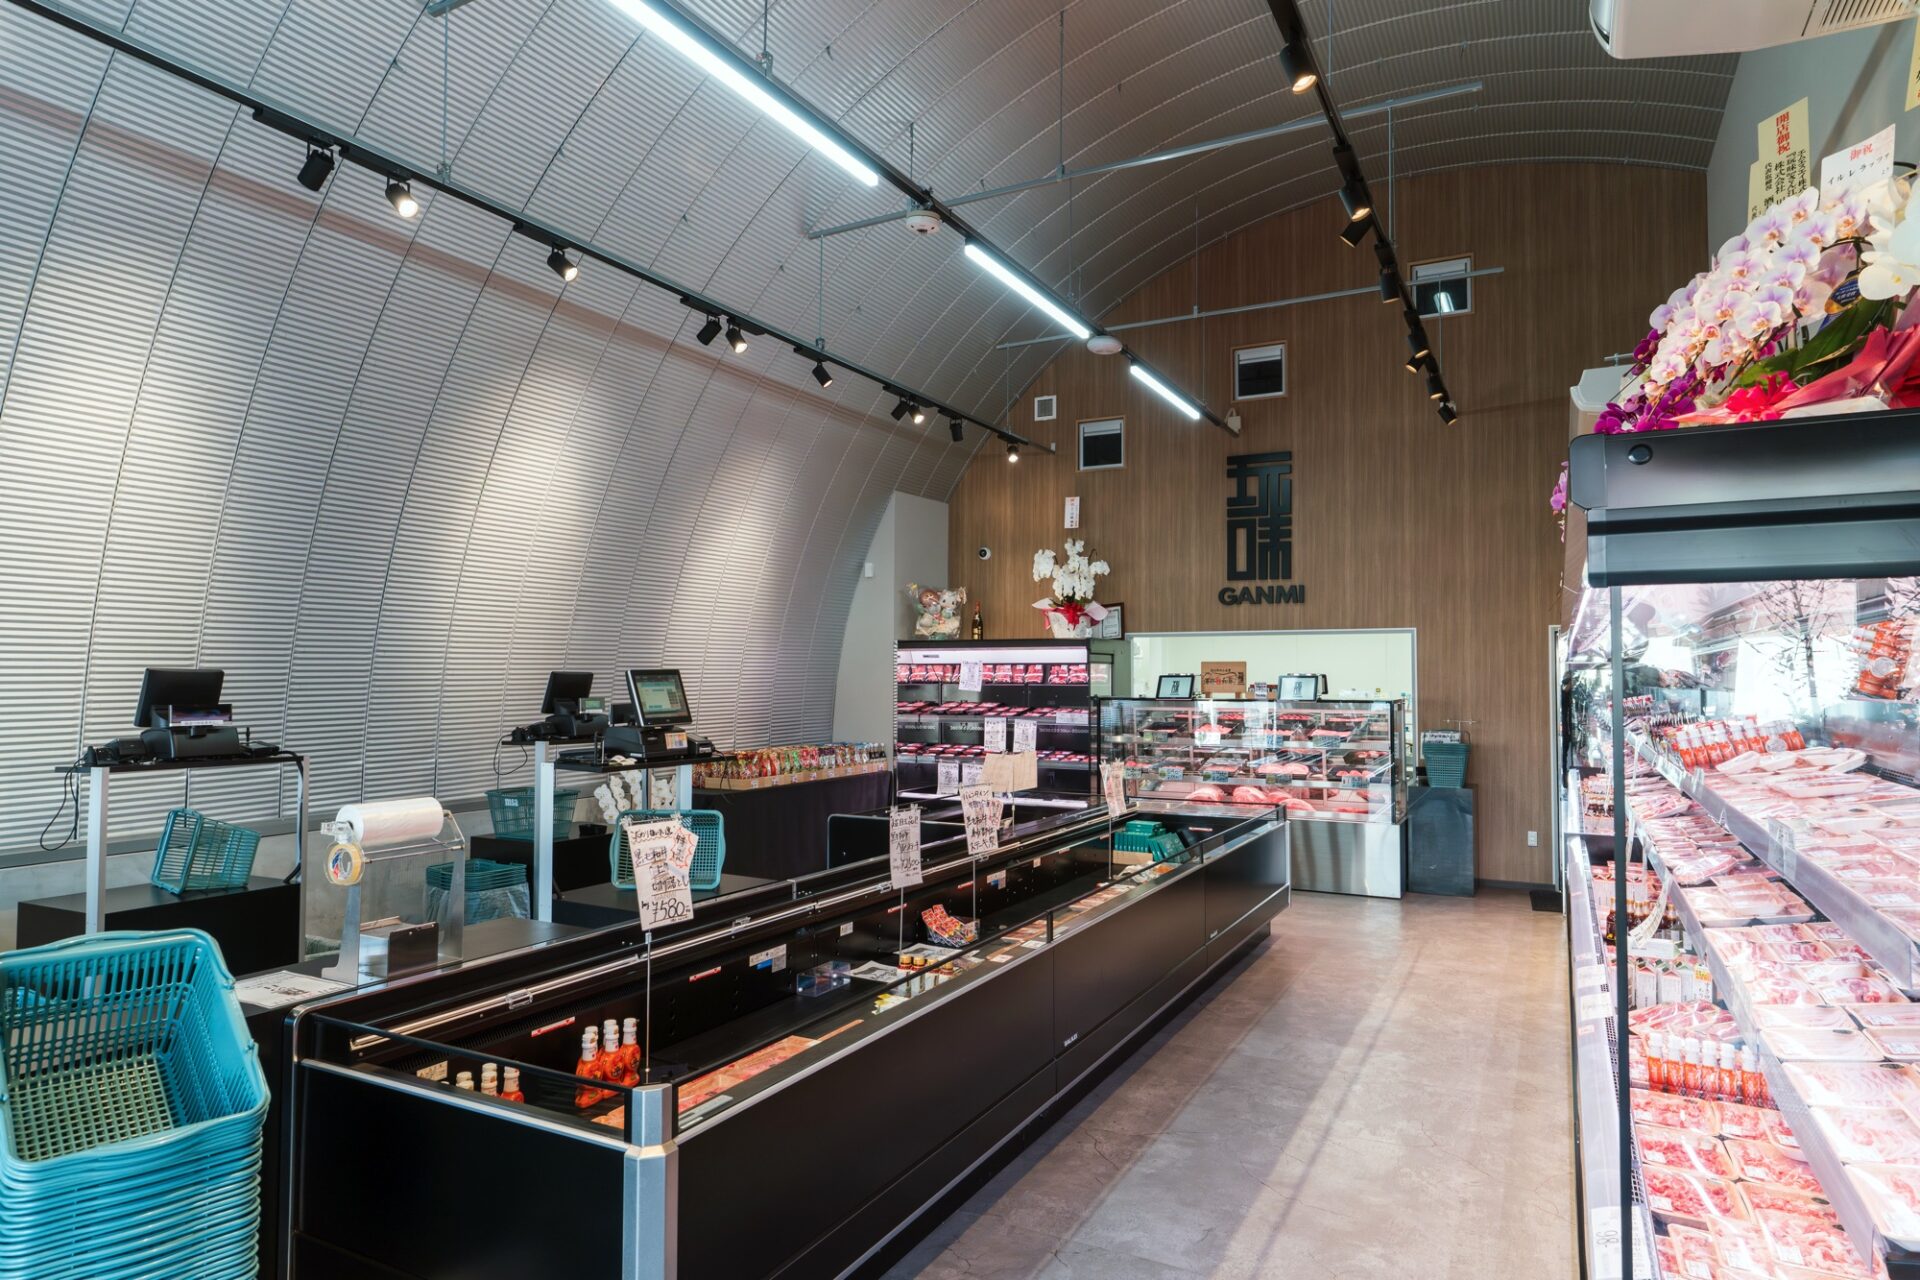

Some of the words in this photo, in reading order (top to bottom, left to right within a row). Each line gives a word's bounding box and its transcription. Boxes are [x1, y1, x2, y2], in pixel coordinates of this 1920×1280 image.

[1776, 111, 1791, 156] 開店御祝
[1850, 143, 1873, 161] 御祝
[1218, 585, 1306, 606] GANMI
